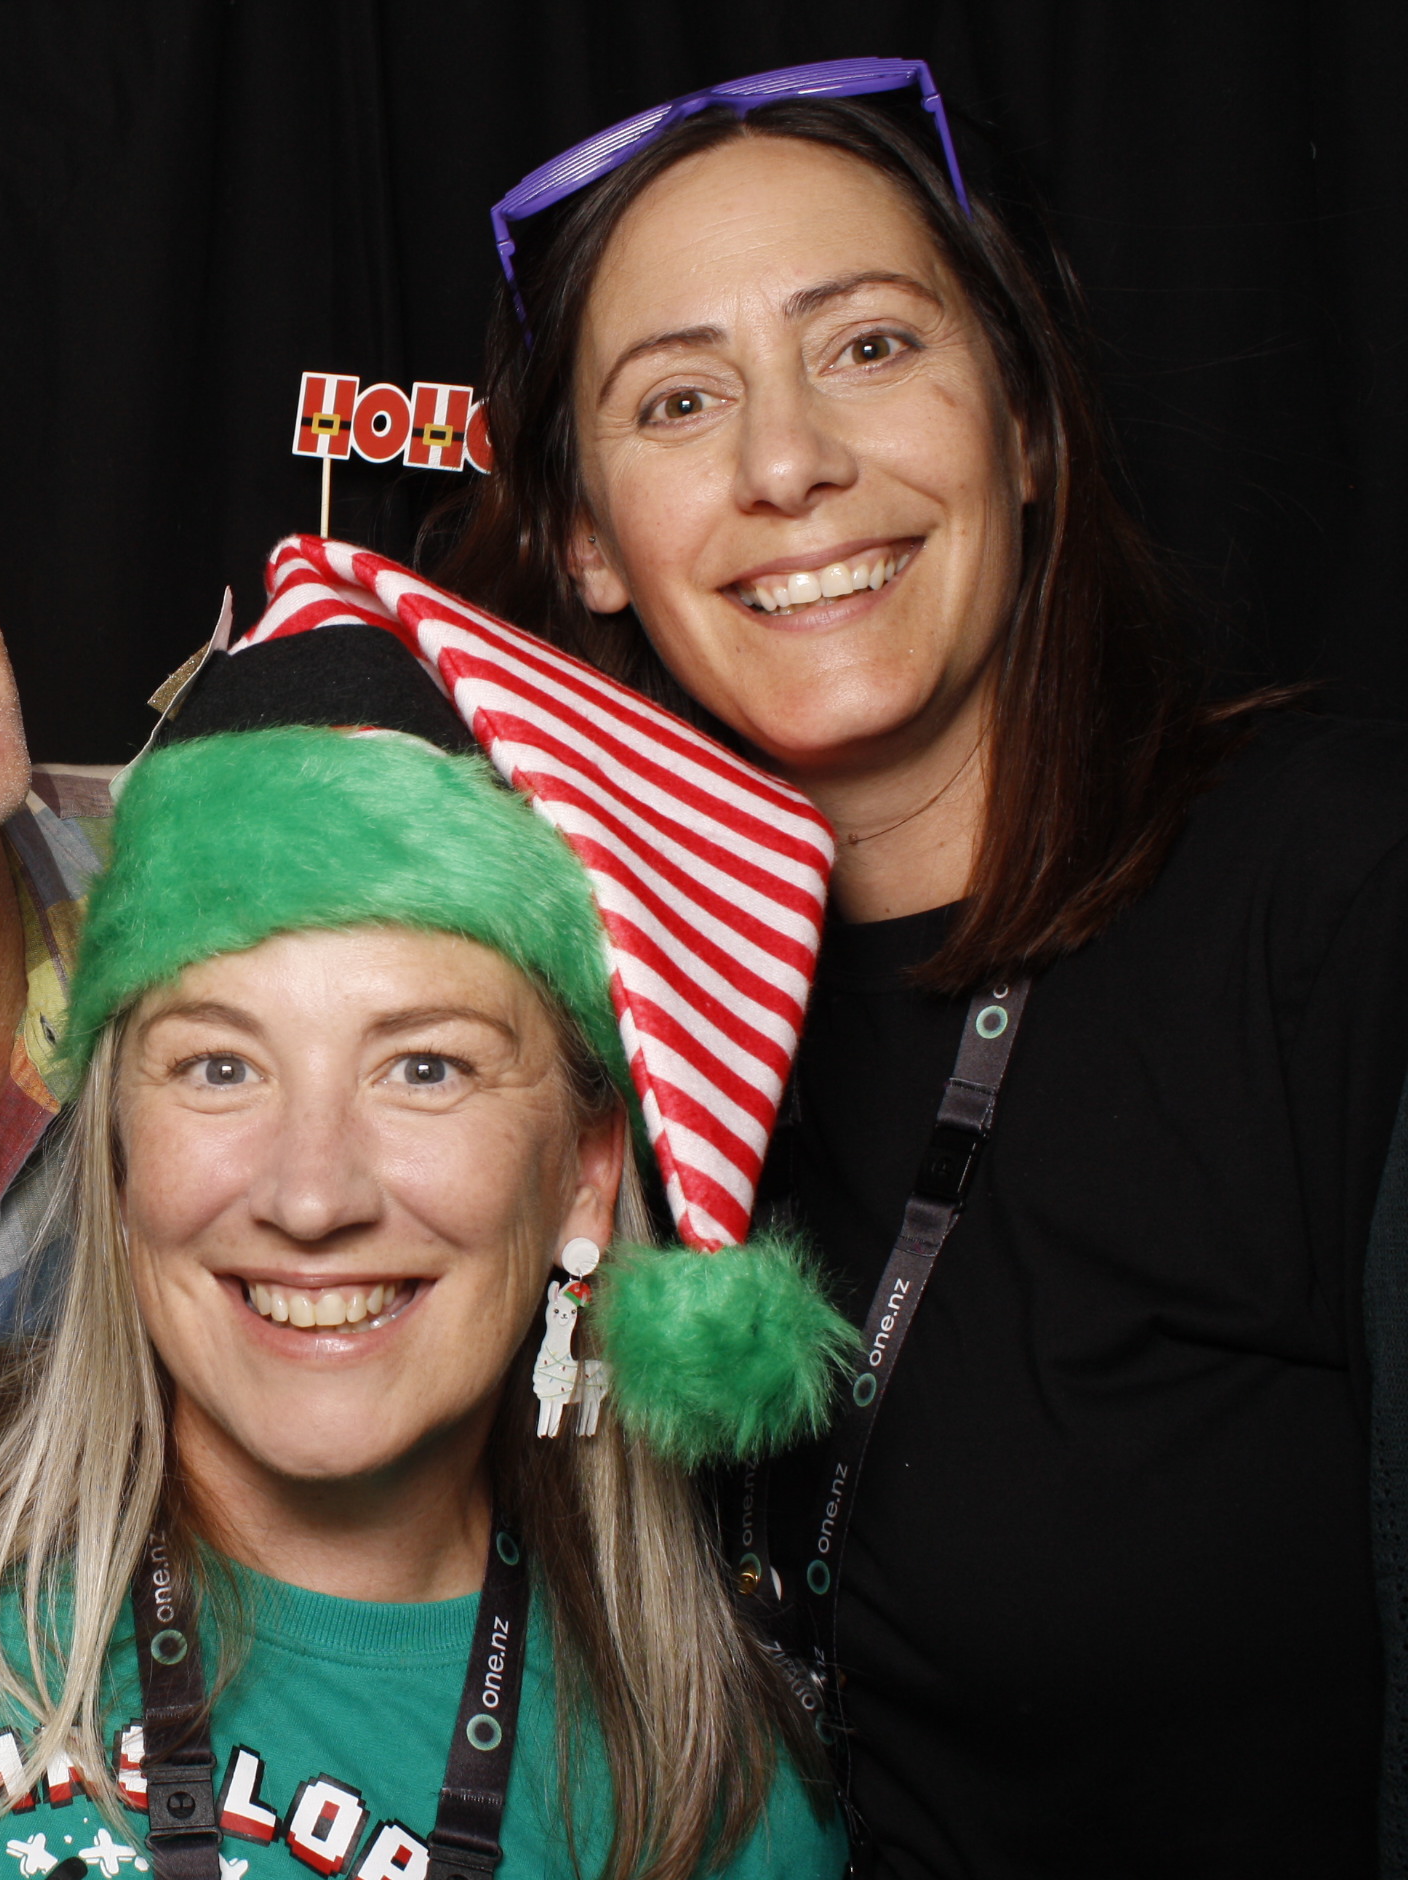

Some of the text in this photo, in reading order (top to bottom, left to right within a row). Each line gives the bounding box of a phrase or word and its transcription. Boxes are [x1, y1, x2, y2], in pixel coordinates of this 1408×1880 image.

[869, 1278, 910, 1367] one.nz
[818, 1462, 848, 1554] one.nz
[150, 1530, 175, 1623] one.nz
[482, 1616, 509, 1708] one.nz
